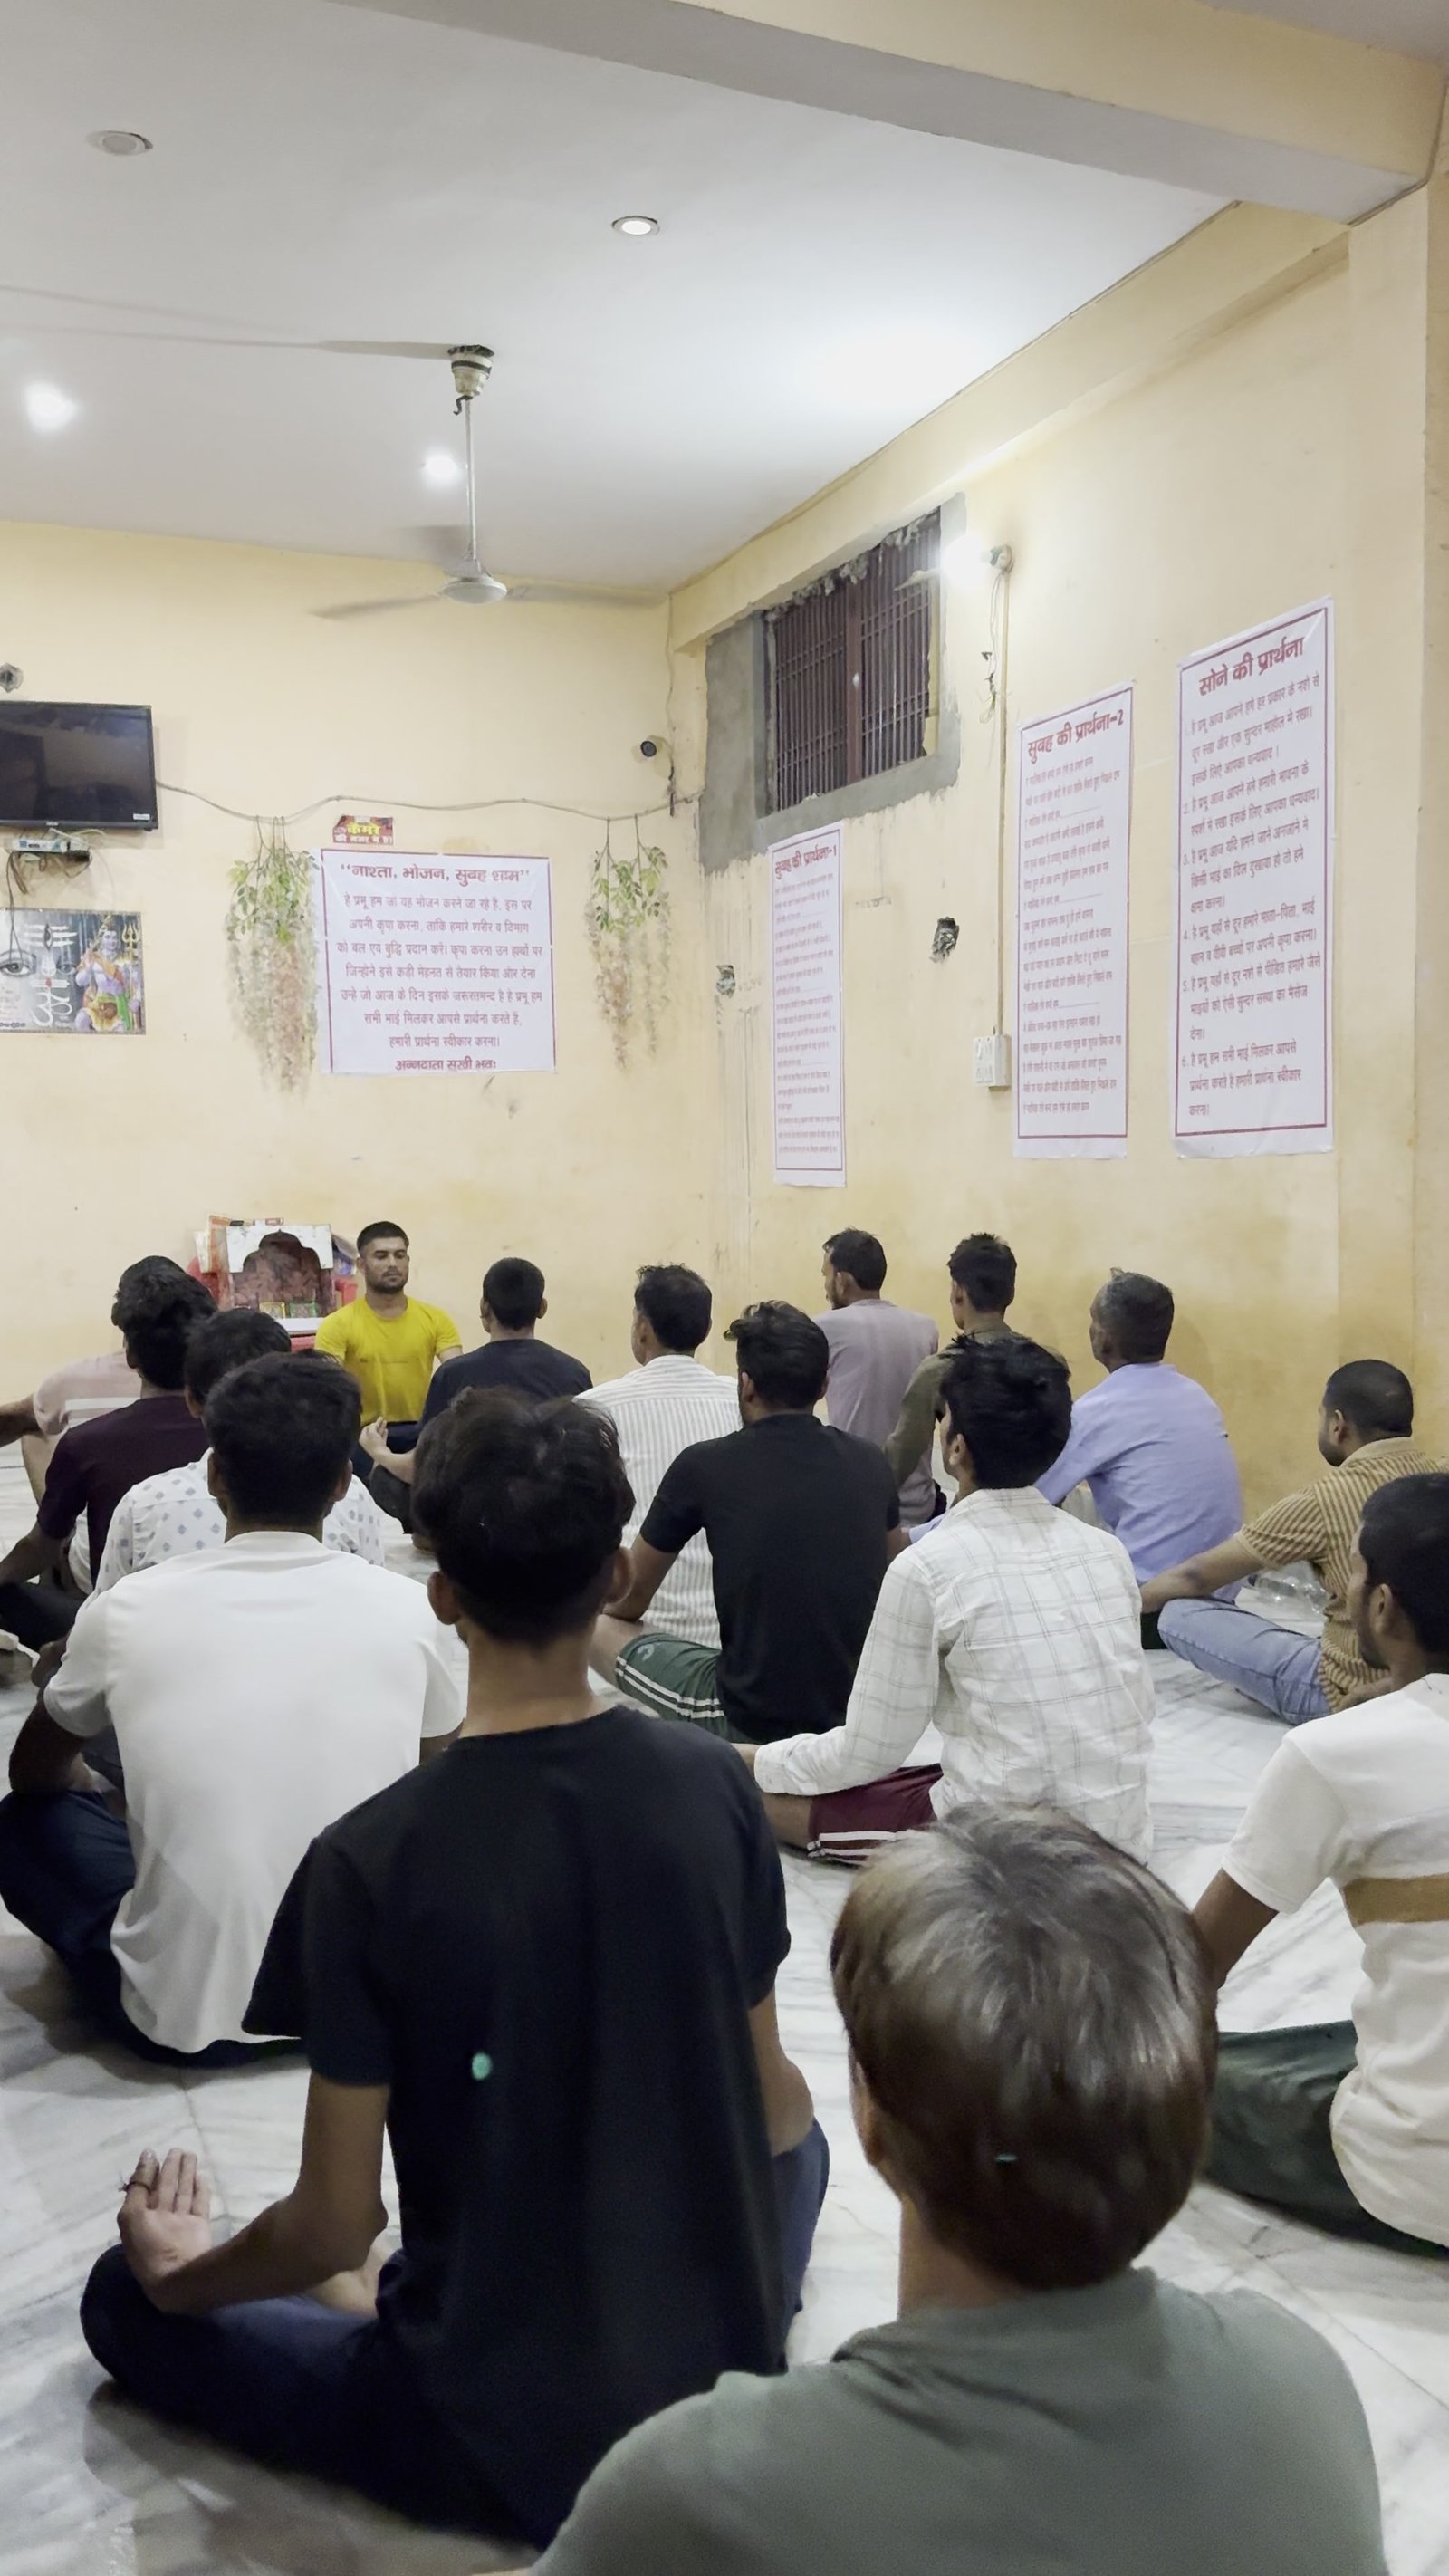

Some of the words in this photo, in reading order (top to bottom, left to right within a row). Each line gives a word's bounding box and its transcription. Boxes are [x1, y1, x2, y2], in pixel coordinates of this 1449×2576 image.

[1199, 664, 1228, 696] सोने
[1233, 652, 1253, 680] की
[1257, 636, 1304, 675] प्रार्थना
[1028, 734, 1055, 764] सुबह
[1056, 722, 1072, 746] की
[792, 851, 801, 870] की
[456, 868, 486, 887] सुबह
[369, 896, 382, 907] हम
[443, 897, 461, 908] करने
[521, 900, 532, 909] पर
[350, 915, 372, 929] अपनी
[427, 919, 447, 931] ताकि
[450, 919, 468, 932] हमारे
[496, 923, 501, 932] व
[337, 940, 348, 953] को
[406, 944, 427, 955] प्रदान
[451, 945, 467, 959] कृपा
[471, 946, 492, 956] करना
[495, 946, 508, 956] उन
[533, 947, 542, 956] पर
[379, 964, 392, 978] इसे
[445, 965, 453, 977] से
[480, 965, 499, 978] किया
[521, 966, 535, 978] देना
[360, 986, 371, 1000] जो
[375, 990, 394, 1000] आज
[397, 987, 406, 1000] के
[408, 986, 425, 1000] दिन
[427, 991, 449, 1003] इसके
[531, 992, 542, 1002] हम
[363, 1010, 381, 1024] सभी
[403, 1010, 434, 1024] मिलकर
[437, 1012, 460, 1024] आपसे
[464, 1011, 488, 1024] प्रार्थना
[491, 1011, 510, 1024] करते
[389, 1033, 411, 1047] हमारी
[415, 1034, 439, 1047] प्रार्थना
[443, 1033, 472, 1046] स्वीकार
[395, 1060, 444, 1070] अन्नदाता
